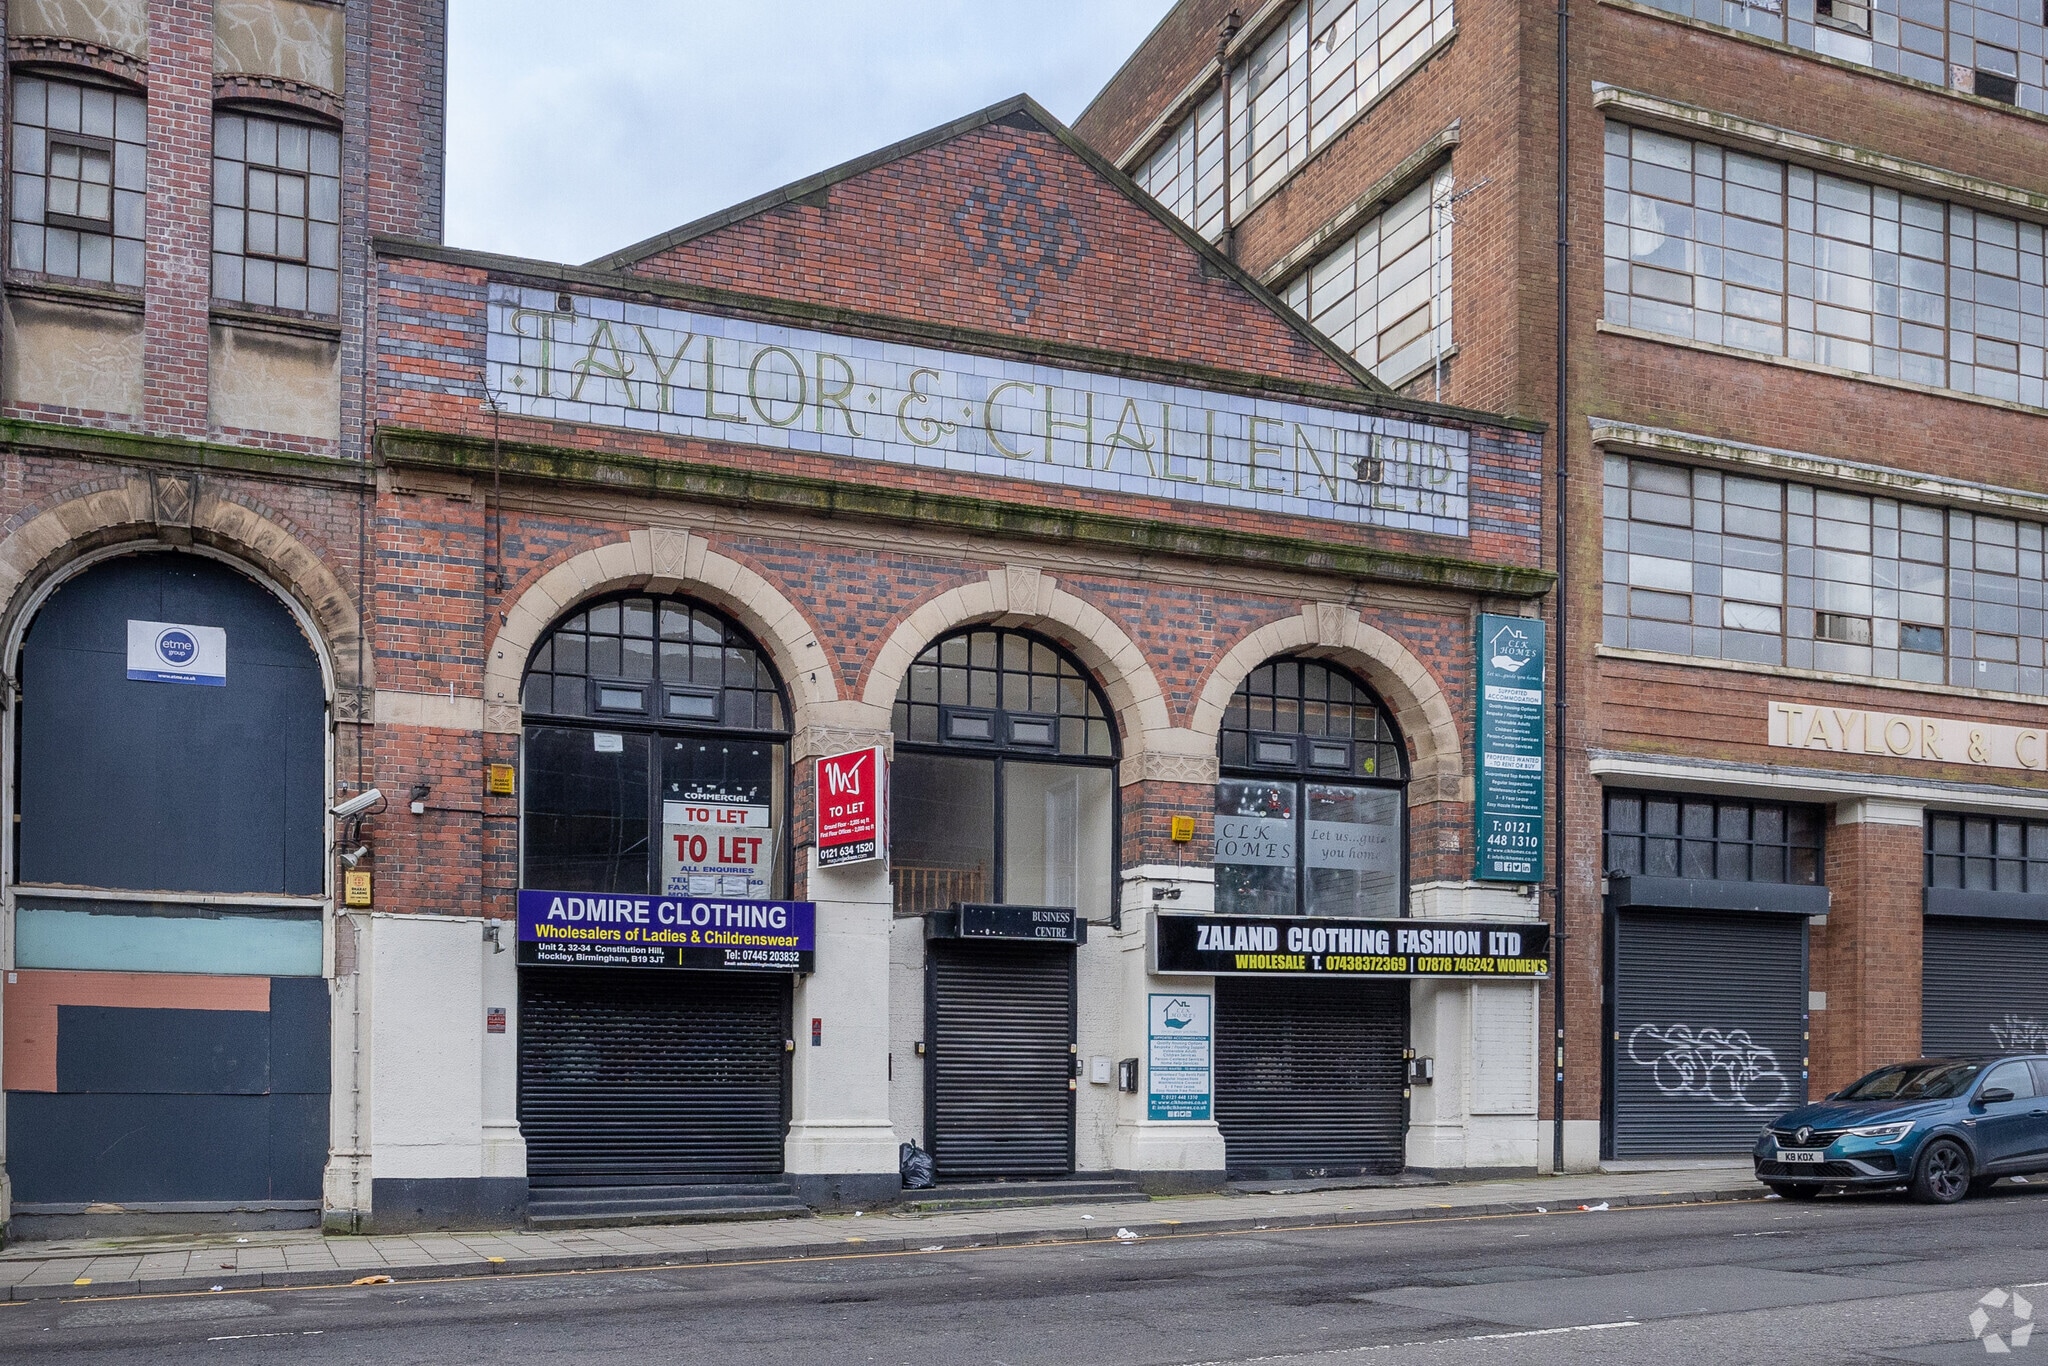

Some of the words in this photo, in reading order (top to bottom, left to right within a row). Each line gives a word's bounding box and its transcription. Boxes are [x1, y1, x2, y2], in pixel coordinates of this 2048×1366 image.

[509, 308, 863, 438] TAYLOR
[897, 367, 958, 447] &
[985, 380, 1340, 502] CHALLEN
[162, 640, 192, 650] etme
[1508, 640, 1529, 648] CLK
[1500, 647, 1536, 657] HOMES
[157, 673, 196, 681] www.etme.co.uk
[1488, 694, 1539, 703] ACCOMMODATION
[1777, 704, 1944, 760] TAYLOR
[1968, 729, 1988, 764] &
[684, 792, 749, 802] COMMERCIAL
[685, 807, 710, 822] TO
[716, 809, 748, 824] LET
[829, 806, 843, 818] TO
[847, 802, 864, 815] LET
[824, 823, 837, 831] Ground
[1223, 823, 1270, 840] CLK
[1493, 821, 1502, 831] T:
[1505, 821, 1531, 833] 0121
[1311, 829, 1331, 841] Let
[1488, 834, 1507, 846] 448
[1512, 836, 1538, 847] 1310
[673, 834, 707, 862] TO
[718, 836, 763, 864] LET
[821, 848, 838, 859] 0121
[840, 846, 854, 856] 634
[856, 842, 874, 853] 1520
[1321, 849, 1344, 861] you
[703, 866, 754, 874] ENQUIRIES
[547, 897, 650, 924] ADMIRE
[657, 902, 786, 929] CLOTHING
[1032, 911, 1070, 923] BUSINESS
[535, 924, 621, 940] Wholesalers
[625, 928, 639, 941] of
[642, 928, 687, 942] Ladies
[691, 930, 701, 943] &
[705, 931, 799, 946] Childrenswear
[1035, 926, 1066, 938] CENTRE
[1197, 925, 1278, 951] ZALAND
[1287, 927, 1390, 955] CLOTHING
[1397, 929, 1481, 955] FASHION
[1489, 931, 1521, 956] LTD
[539, 943, 556, 951] Unit
[558, 944, 566, 952] 2,
[568, 944, 591, 952] 32-34
[595, 945, 646, 954] Constitution
[648, 947, 664, 955] Hill,
[538, 952, 574, 961] Hockley,
[576, 954, 629, 963] Birmingham,
[725, 949, 740, 960] Tel:
[743, 950, 768, 961] 07445
[769, 951, 799, 962] 203832
[1235, 954, 1305, 970] WHOLESALE
[1312, 956, 1322, 970] T.
[1325, 955, 1407, 971] 07438372369
[1417, 957, 1452, 971] 07878
[1454, 958, 1495, 972] 746242
[1497, 958, 1548, 973] WOMEN'S
[1785, 1153, 1796, 1161] K8
